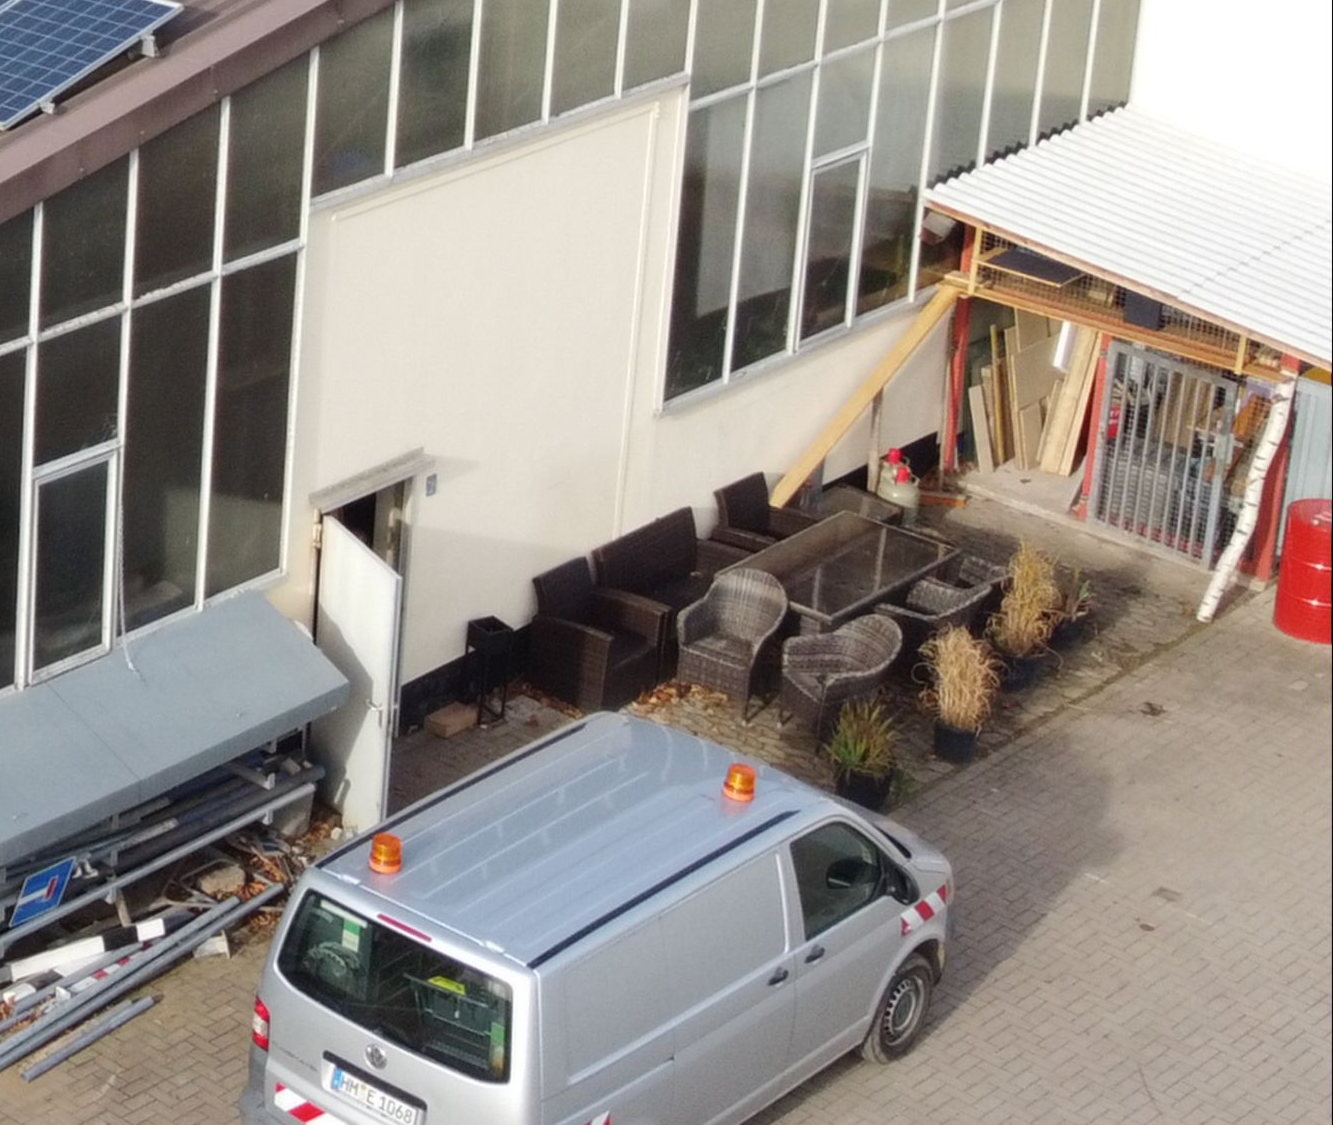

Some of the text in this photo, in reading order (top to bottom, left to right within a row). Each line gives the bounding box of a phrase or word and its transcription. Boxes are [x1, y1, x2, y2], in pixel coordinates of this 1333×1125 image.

[341, 1076, 413, 1124] HM E 1068
